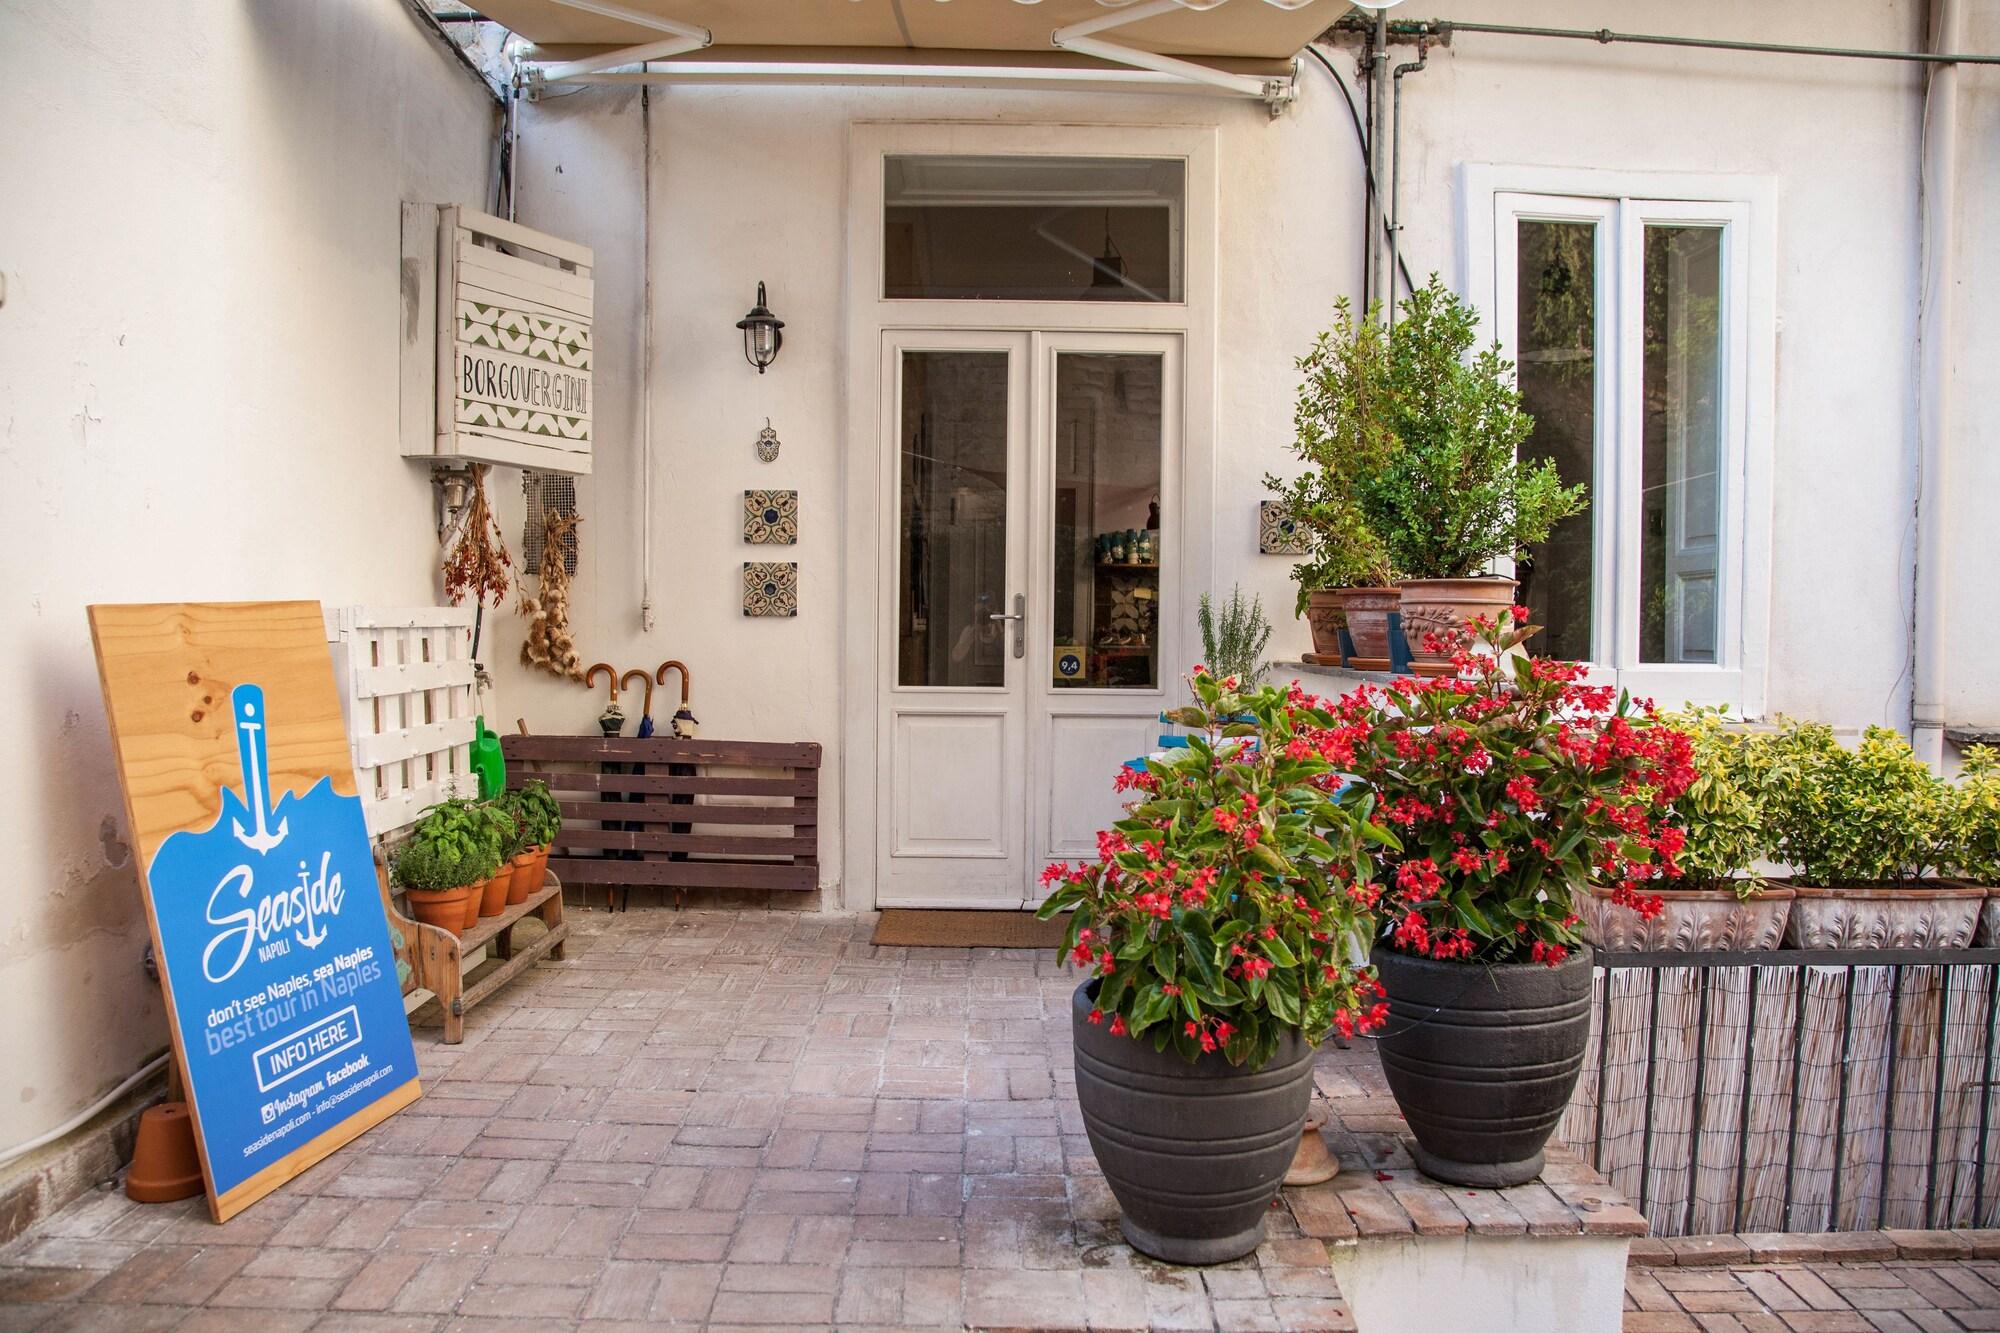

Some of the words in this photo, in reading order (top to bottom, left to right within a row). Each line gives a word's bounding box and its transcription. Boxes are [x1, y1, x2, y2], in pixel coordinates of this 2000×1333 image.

[463, 355, 587, 414] BORGOVERGINI
[1061, 661, 1078, 671] 9,4
[202, 851, 346, 983] Seaside
[258, 938, 290, 963] NAPOLI
[204, 1014, 255, 1056] best
[256, 996, 297, 1031] tour
[300, 989, 318, 1012] in
[320, 961, 382, 1003] Naples
[207, 1000, 243, 1027] don't
[244, 993, 267, 1013] see
[267, 972, 312, 1002] Naples,
[313, 964, 334, 982] sea
[334, 946, 374, 971] Naples
[269, 1041, 307, 1075] INFO
[308, 1020, 349, 1055] HERE
[243, 1111, 312, 1157] seasidenapoli.com
[315, 1064, 394, 1115] info@seasidenapoli.com
[274, 1081, 325, 1117] Instagram
[326, 1053, 370, 1087] facebook
